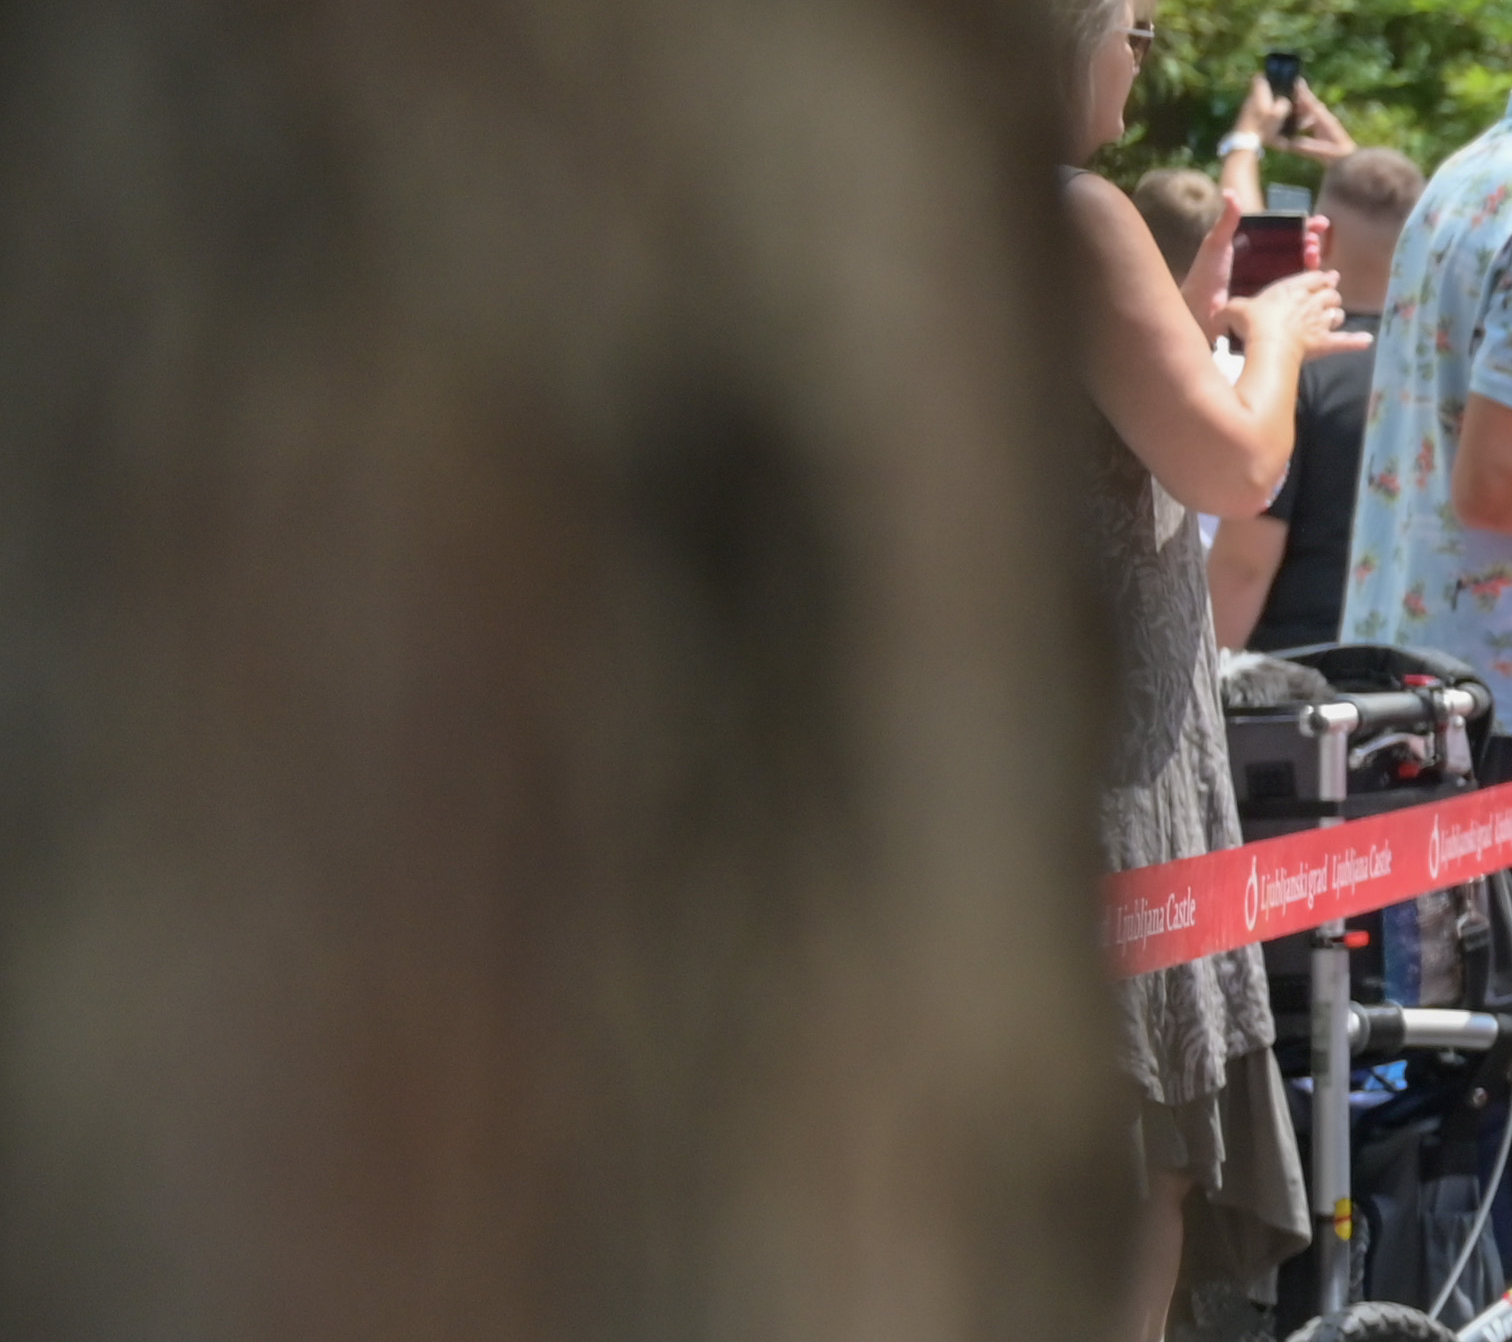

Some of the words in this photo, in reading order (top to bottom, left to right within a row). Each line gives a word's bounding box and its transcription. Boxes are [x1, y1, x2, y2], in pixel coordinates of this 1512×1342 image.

[1308, 853, 1329, 910] grad
[1332, 847, 1369, 900] Ljubljana
[1115, 897, 1166, 957] Ljubljana
[1166, 885, 1197, 932] Castle
